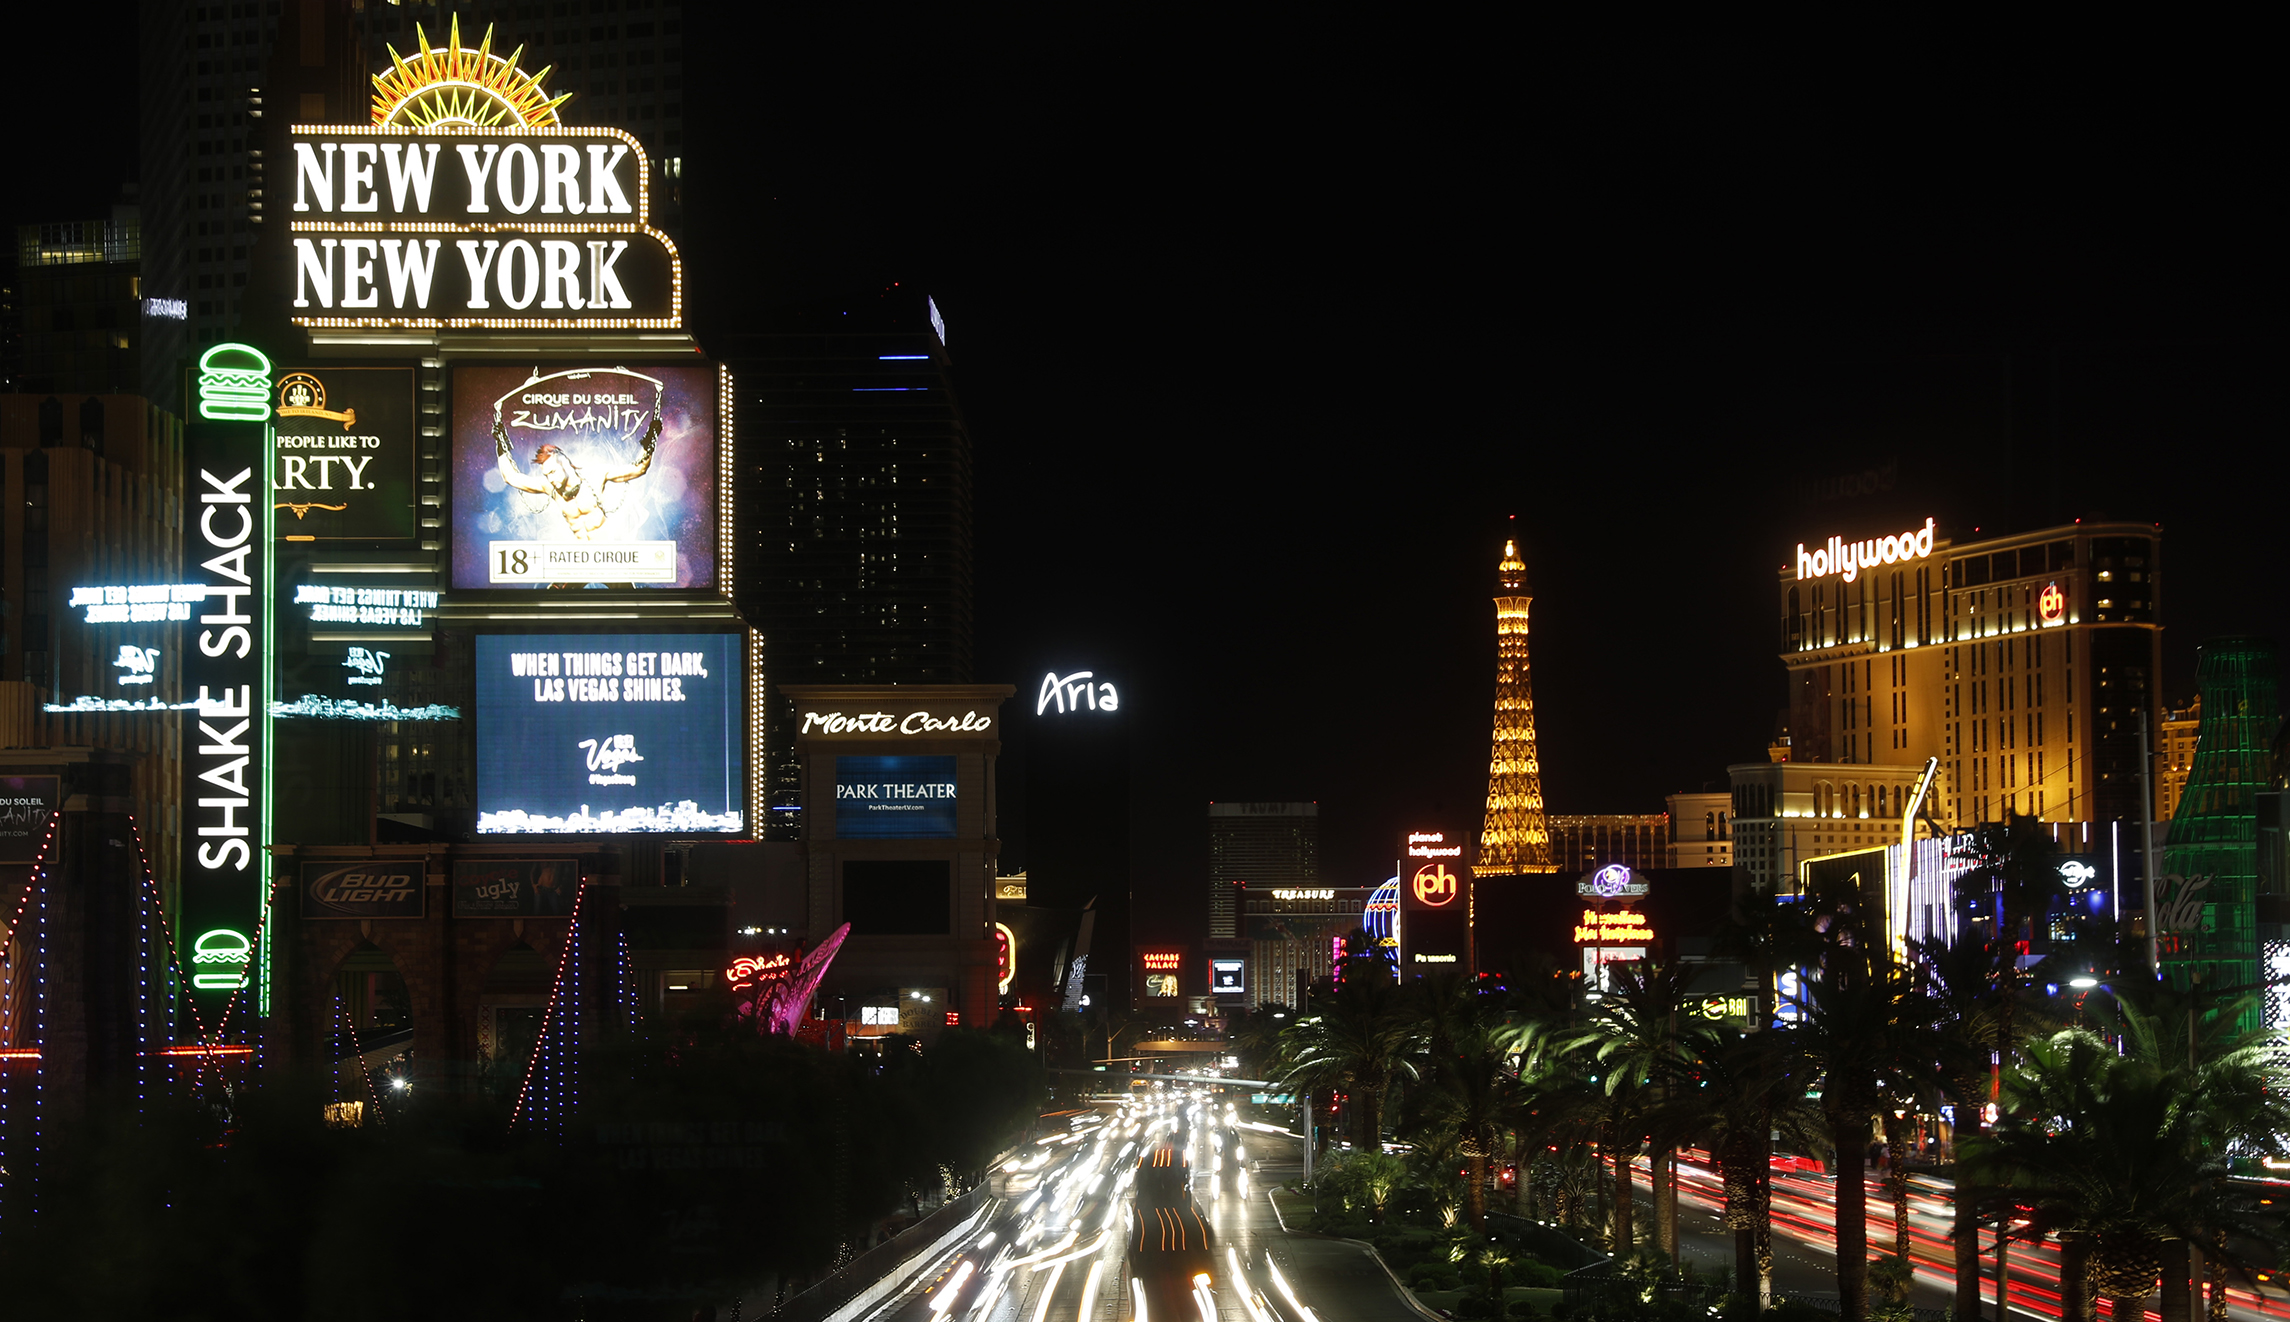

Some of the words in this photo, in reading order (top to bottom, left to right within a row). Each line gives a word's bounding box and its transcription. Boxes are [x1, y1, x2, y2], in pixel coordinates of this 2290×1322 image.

[293, 143, 441, 213] NEW
[456, 142, 632, 215] YORK
[293, 239, 441, 309] NEW
[456, 239, 632, 310] YORK
[522, 394, 569, 407] CIRQUE
[573, 394, 591, 405] DU
[594, 394, 638, 405] SOLEIL
[511, 405, 649, 441] ZUMANITY
[276, 435, 325, 449] PEOPLE
[328, 435, 359, 449] LIKE
[360, 435, 380, 449] TO
[549, 551, 590, 563] RATED
[594, 551, 639, 563] CIRQUE
[1797, 517, 1933, 583] hollywood
[200, 466, 253, 659] SHACK
[511, 652, 560, 676] WHEN
[562, 652, 623, 676] THINGS
[626, 652, 656, 676] GET
[660, 652, 708, 678] DARK,
[534, 678, 565, 701] LAS
[567, 678, 619, 701] VEGAS
[623, 678, 686, 701] SHINES.
[1036, 670, 1118, 715] Aria
[801, 711, 897, 734] Monte
[900, 711, 991, 734] Carlo
[198, 684, 251, 871] SHAKE
[836, 784, 879, 799] PARK
[883, 784, 956, 799] THEATER
[13, 797, 44, 806] SOLEIL
[868, 804, 924, 812] ParkTheaterLV.com
[1240, 802, 1287, 814] TRUMP
[0, 806, 52, 830] ANITY
[1408, 831, 1444, 845] planet
[1408, 845, 1461, 859] hollywood
[339, 873, 411, 888] BUD
[1419, 864, 1456, 901] ph
[322, 888, 416, 901] LIGHT
[475, 878, 520, 900] ugly
[1271, 889, 1336, 900] TREASURE
[1143, 952, 1181, 962] CAESARS
[1145, 961, 1179, 970] PALACE
[900, 1007, 939, 1020] DOUBLE
[903, 1020, 938, 1028] BARREL
